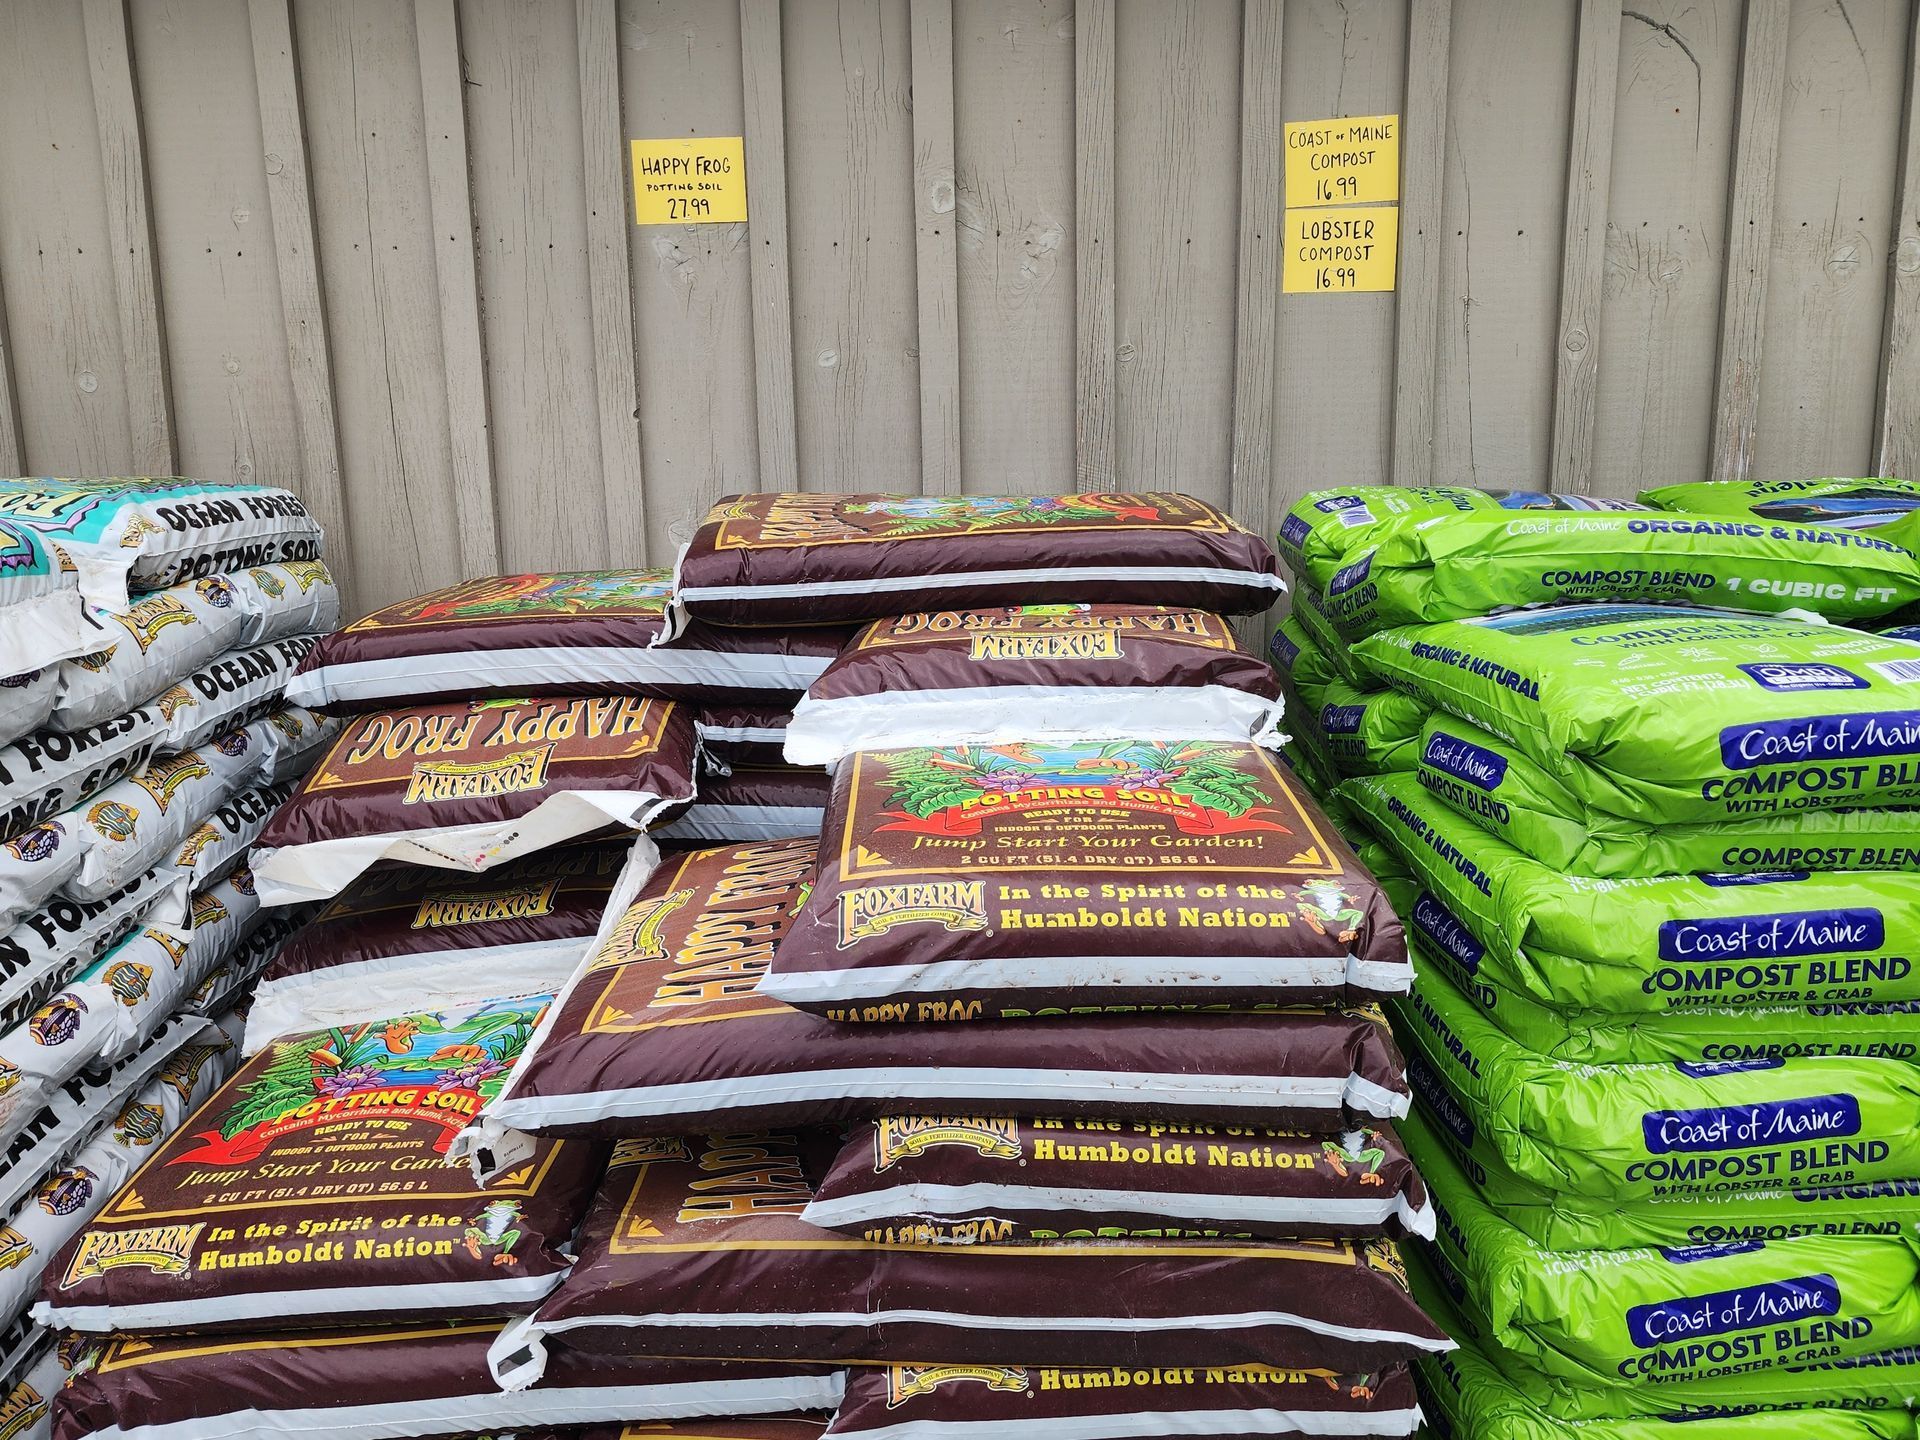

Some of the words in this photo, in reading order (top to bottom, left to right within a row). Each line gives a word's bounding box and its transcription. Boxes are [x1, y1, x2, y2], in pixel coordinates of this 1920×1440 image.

[1289, 131, 1332, 148] COAST
[1350, 124, 1393, 143] MAINE
[642, 157, 690, 175] HAPPY
[696, 156, 731, 175] FROG
[1311, 151, 1376, 170] COMPOST
[646, 183, 694, 192] POTTING
[698, 182, 722, 191] SOIL
[1317, 176, 1357, 200] 16.99
[667, 198, 710, 219] 27.99
[1302, 220, 1374, 240] LOBSTER
[1300, 245, 1374, 261] COMPOST
[1316, 267, 1356, 289] 16.99
[1507, 519, 1552, 537] Coast
[1555, 518, 1570, 534] of
[1571, 518, 1624, 534] Maine
[1627, 519, 1765, 538] ORGANIC
[1770, 526, 1791, 541] &
[1541, 570, 1649, 587] COMPOST
[1649, 570, 1717, 589] BLEND
[1726, 578, 1742, 592] 1
[1748, 578, 1847, 600] CUBIC
[1855, 587, 1898, 602] FT
[968, 630, 1125, 660] FOXFARM
[1571, 624, 1731, 647] Compost
[1616, 638, 1676, 649] WITH
[192, 649, 277, 701] OCEAN
[1411, 641, 1460, 668] ORGANIC
[1459, 653, 1471, 669] &
[1470, 656, 1540, 702] NATURAL
[484, 696, 653, 747] HAPPY
[348, 708, 484, 765] FROG
[1739, 723, 1818, 760] Coast
[1824, 719, 1851, 752] of
[1851, 719, 1920, 750] Main
[1427, 732, 1453, 765] Coast
[1450, 747, 1463, 775] of
[1459, 750, 1498, 782] Maine
[403, 742, 558, 804] FOXFARM
[960, 803, 1009, 820] Contains
[1093, 799, 1117, 808] and
[1120, 800, 1161, 813] Humic
[1164, 805, 1198, 819] Acids
[961, 786, 1108, 812] POTTING
[1116, 786, 1190, 809] SOIL
[1022, 807, 1072, 819] READY
[1074, 807, 1097, 816] TO
[1101, 808, 1131, 818] USE
[1064, 816, 1093, 824] FOR
[912, 834, 987, 852] Jump
[996, 834, 1068, 849] Start
[1076, 834, 1142, 849] Your
[1150, 834, 1264, 849] Garden!
[1387, 796, 1428, 838] ORGANIC
[1423, 828, 1436, 845] &
[1432, 834, 1493, 899] NATURAL
[961, 855, 972, 865] 2
[979, 855, 1001, 865] CU
[1004, 855, 1029, 864] FT
[1036, 854, 1077, 866] (51.4
[1085, 855, 1118, 864] DRY
[1160, 855, 1199, 864] 56.6
[1205, 855, 1216, 864] L
[1722, 848, 1856, 866] COMPOST
[1859, 848, 1920, 865] BLEN
[411, 876, 567, 929] FOXFARM
[999, 885, 1031, 900] In
[1040, 884, 1090, 899] the
[1100, 884, 1187, 902] Spirit
[1196, 884, 1229, 899] of
[1236, 885, 1287, 900] the
[836, 880, 987, 951] FOXFARM
[1000, 907, 1167, 929] Humboldt
[1416, 899, 1441, 932] Coast
[1436, 923, 1449, 940] of
[1444, 924, 1475, 964] Maine
[1675, 923, 1752, 954] Coast
[1758, 918, 1786, 949] of
[1785, 918, 1868, 949] Maine
[1641, 963, 1802, 994] COMPOST
[1808, 957, 1912, 984] BLEND
[1667, 994, 1718, 1008] WITH
[1804, 990, 1817, 1000] &
[1823, 987, 1873, 999] CRAB
[1701, 1043, 1834, 1060] COMPOST
[273, 1090, 416, 1125] POTTING
[421, 1091, 477, 1116] SOIL
[314, 1121, 364, 1136] READY
[365, 1120, 383, 1130] TO
[386, 1120, 413, 1131] USE
[343, 1132, 369, 1141] FOR
[1660, 1116, 1732, 1145] Coast
[1738, 1111, 1763, 1141] of
[1763, 1108, 1845, 1138] Maine
[1033, 1140, 1197, 1165] Humboldt
[1625, 1152, 1781, 1183] COMPOST
[1790, 1140, 1890, 1172] BLEND
[175, 1170, 249, 1191] Jump
[252, 1161, 322, 1181] Start
[325, 1156, 387, 1175] Your
[1653, 1183, 1702, 1197] WITH
[1705, 1177, 1784, 1192] LOBSTER
[1788, 1175, 1802, 1186] &
[1808, 1170, 1855, 1183] CRAB
[202, 1194, 215, 1203] 2
[218, 1191, 240, 1203] CU
[242, 1190, 266, 1201] FT
[268, 1186, 305, 1200] (51.4
[310, 1185, 344, 1197] DRY
[348, 1182, 375, 1194] QT)
[378, 1181, 416, 1191] 56.6
[418, 1181, 428, 1190] L
[207, 1226, 236, 1242] In
[244, 1224, 287, 1240] the
[295, 1216, 375, 1236] Spirit
[384, 1214, 412, 1229] of
[419, 1213, 463, 1228] the
[1687, 1224, 1819, 1243] COMPOST
[1823, 1221, 1902, 1236] BLEND
[58, 1222, 208, 1291] FOXFARM
[199, 1240, 345, 1272] Humboldt
[1645, 1307, 1715, 1338] Coast
[1721, 1296, 1745, 1324] of
[1746, 1289, 1826, 1322] Maine
[1617, 1333, 1767, 1379] COMPOST
[1775, 1316, 1873, 1351] BLEND
[1697, 1359, 1773, 1379] LOBSTER
[1777, 1355, 1790, 1366] &
[1795, 1345, 1841, 1361] CRAB
[1039, 1367, 1196, 1390] Humboldt
